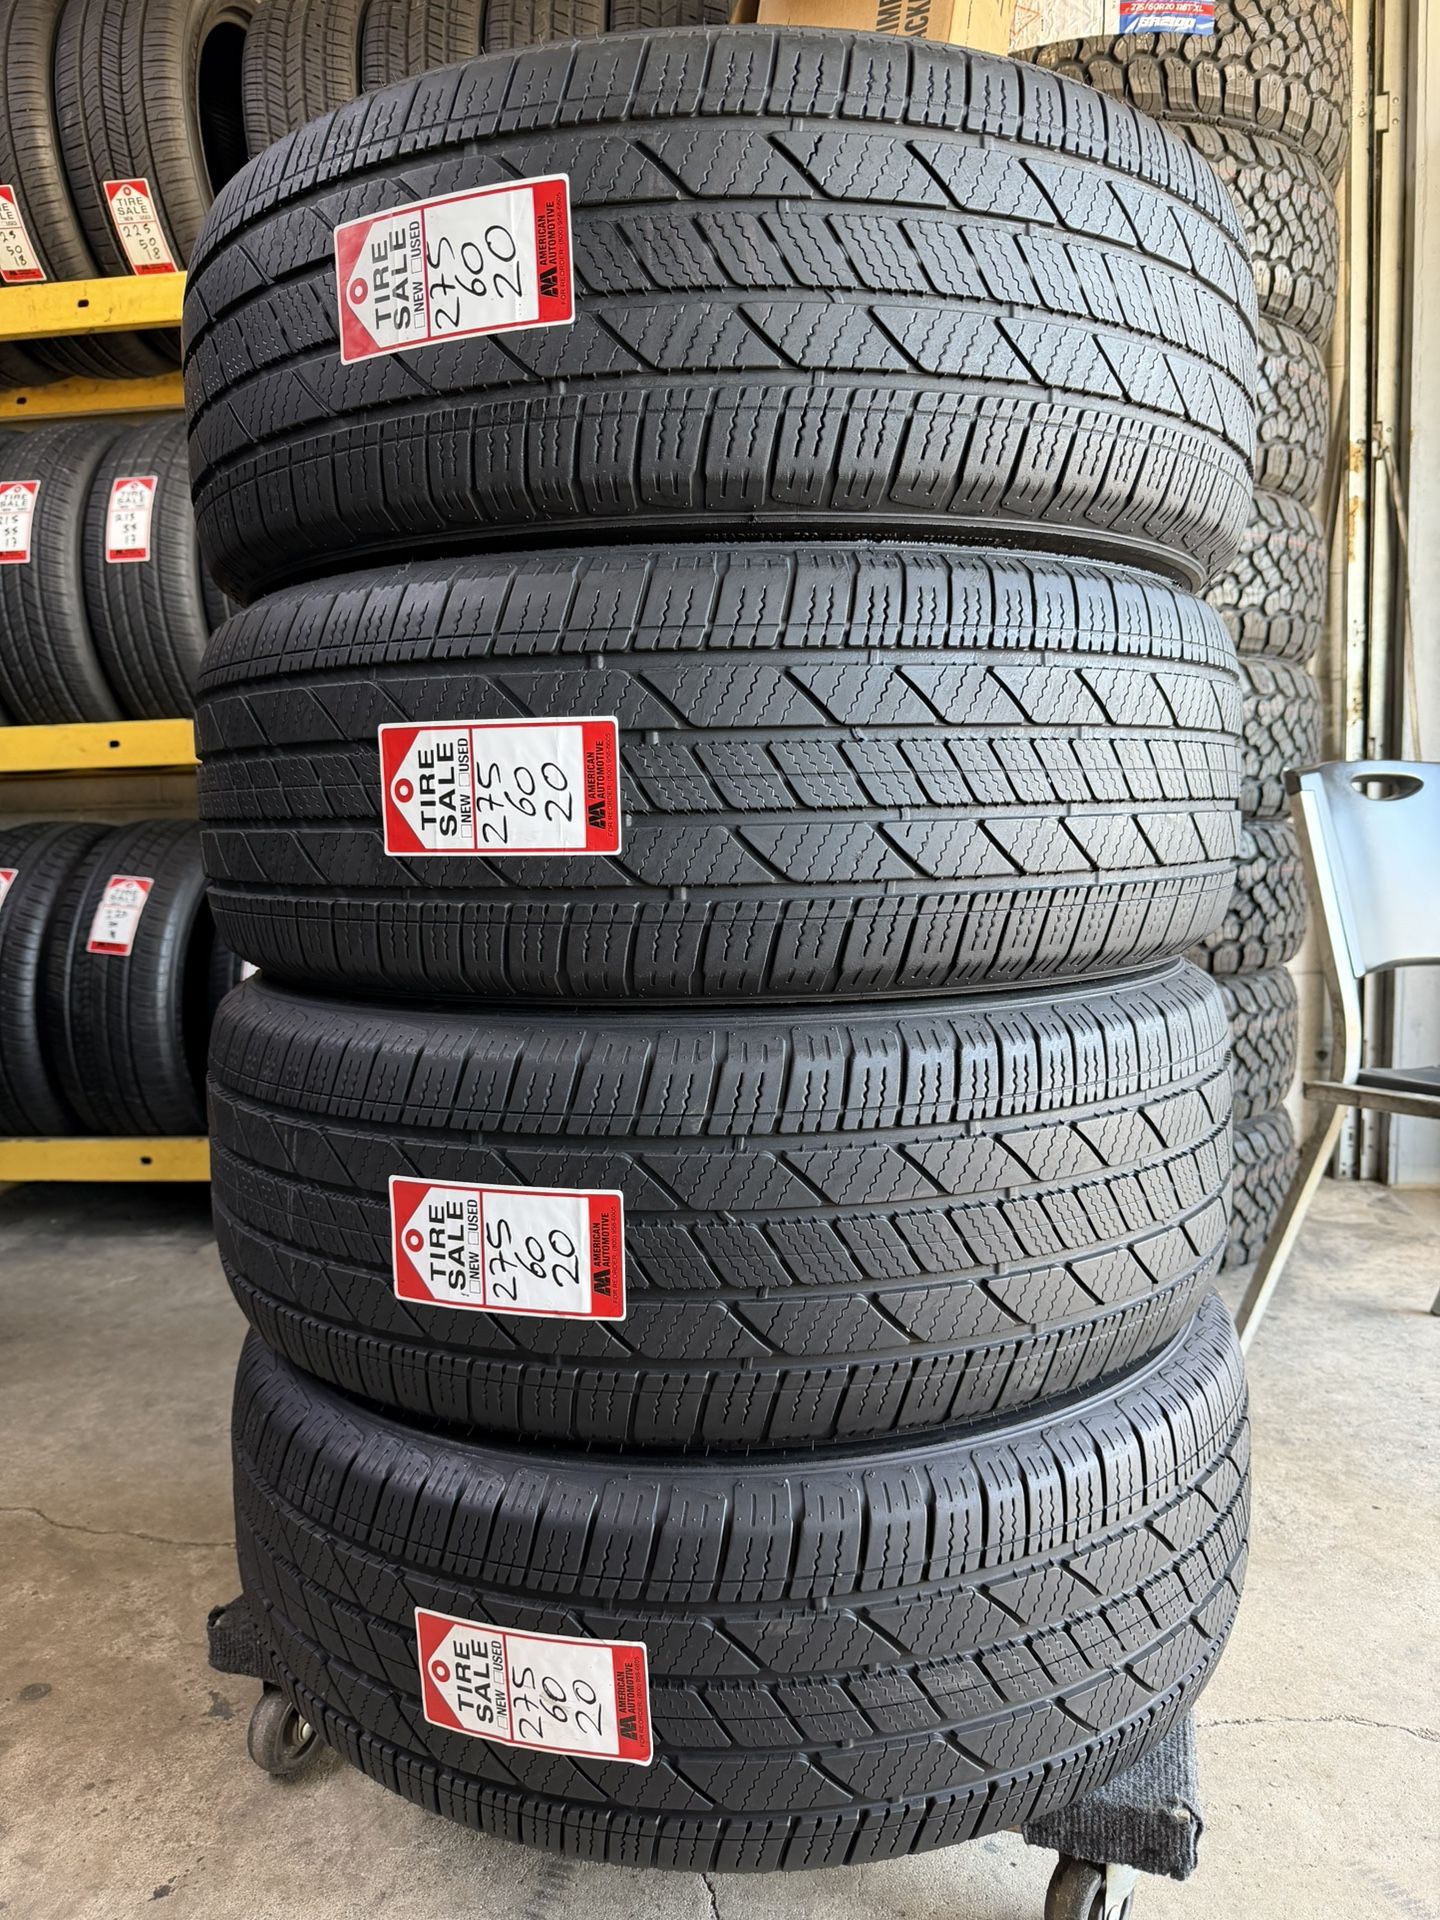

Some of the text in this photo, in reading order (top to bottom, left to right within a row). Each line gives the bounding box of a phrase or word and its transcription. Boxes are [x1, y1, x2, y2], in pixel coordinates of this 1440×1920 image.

[116, 196, 144, 206] TIRE
[118, 205, 148, 216] SALE
[122, 223, 150, 238] 225
[138, 238, 156, 250] 50
[147, 246, 160, 260] 18
[485, 225, 522, 298] 20
[538, 215, 548, 266] AMERICAN
[546, 202, 556, 265] AUTOMOTIVE
[372, 240, 392, 330] TIRE
[389, 227, 410, 330] SALE
[409, 220, 425, 314] NEW USED
[427, 236, 460, 329] 275
[455, 242, 487, 296] 60
[418, 750, 437, 830] TIRE
[436, 742, 457, 836] SALE
[458, 738, 472, 824] NEW USED
[504, 766, 536, 816] 60
[541, 762, 572, 822] 20
[587, 752, 596, 799] AMERICAN
[596, 740, 606, 799] AUTOMOTIVE
[476, 762, 508, 844] 275
[429, 1204, 447, 1281] TIRE
[446, 1201, 466, 1290] SALE
[467, 1199, 480, 1280] NEW USED
[486, 1218, 518, 1301] 275
[515, 1236, 546, 1279] 60
[548, 1230, 580, 1287] 20
[592, 1222, 601, 1267] AMERICAN
[601, 1212, 610, 1267] AUTOMOTIVE
[453, 1640, 474, 1712] TIRE
[472, 1640, 494, 1724] SALE
[491, 1640, 508, 1716] NEW USED
[512, 1666, 544, 1738] 275
[540, 1676, 568, 1722] 60
[617, 1672, 626, 1713] AMERICAN
[625, 1662, 635, 1713] AUTOMOTIVE
[573, 1680, 602, 1736] 20
